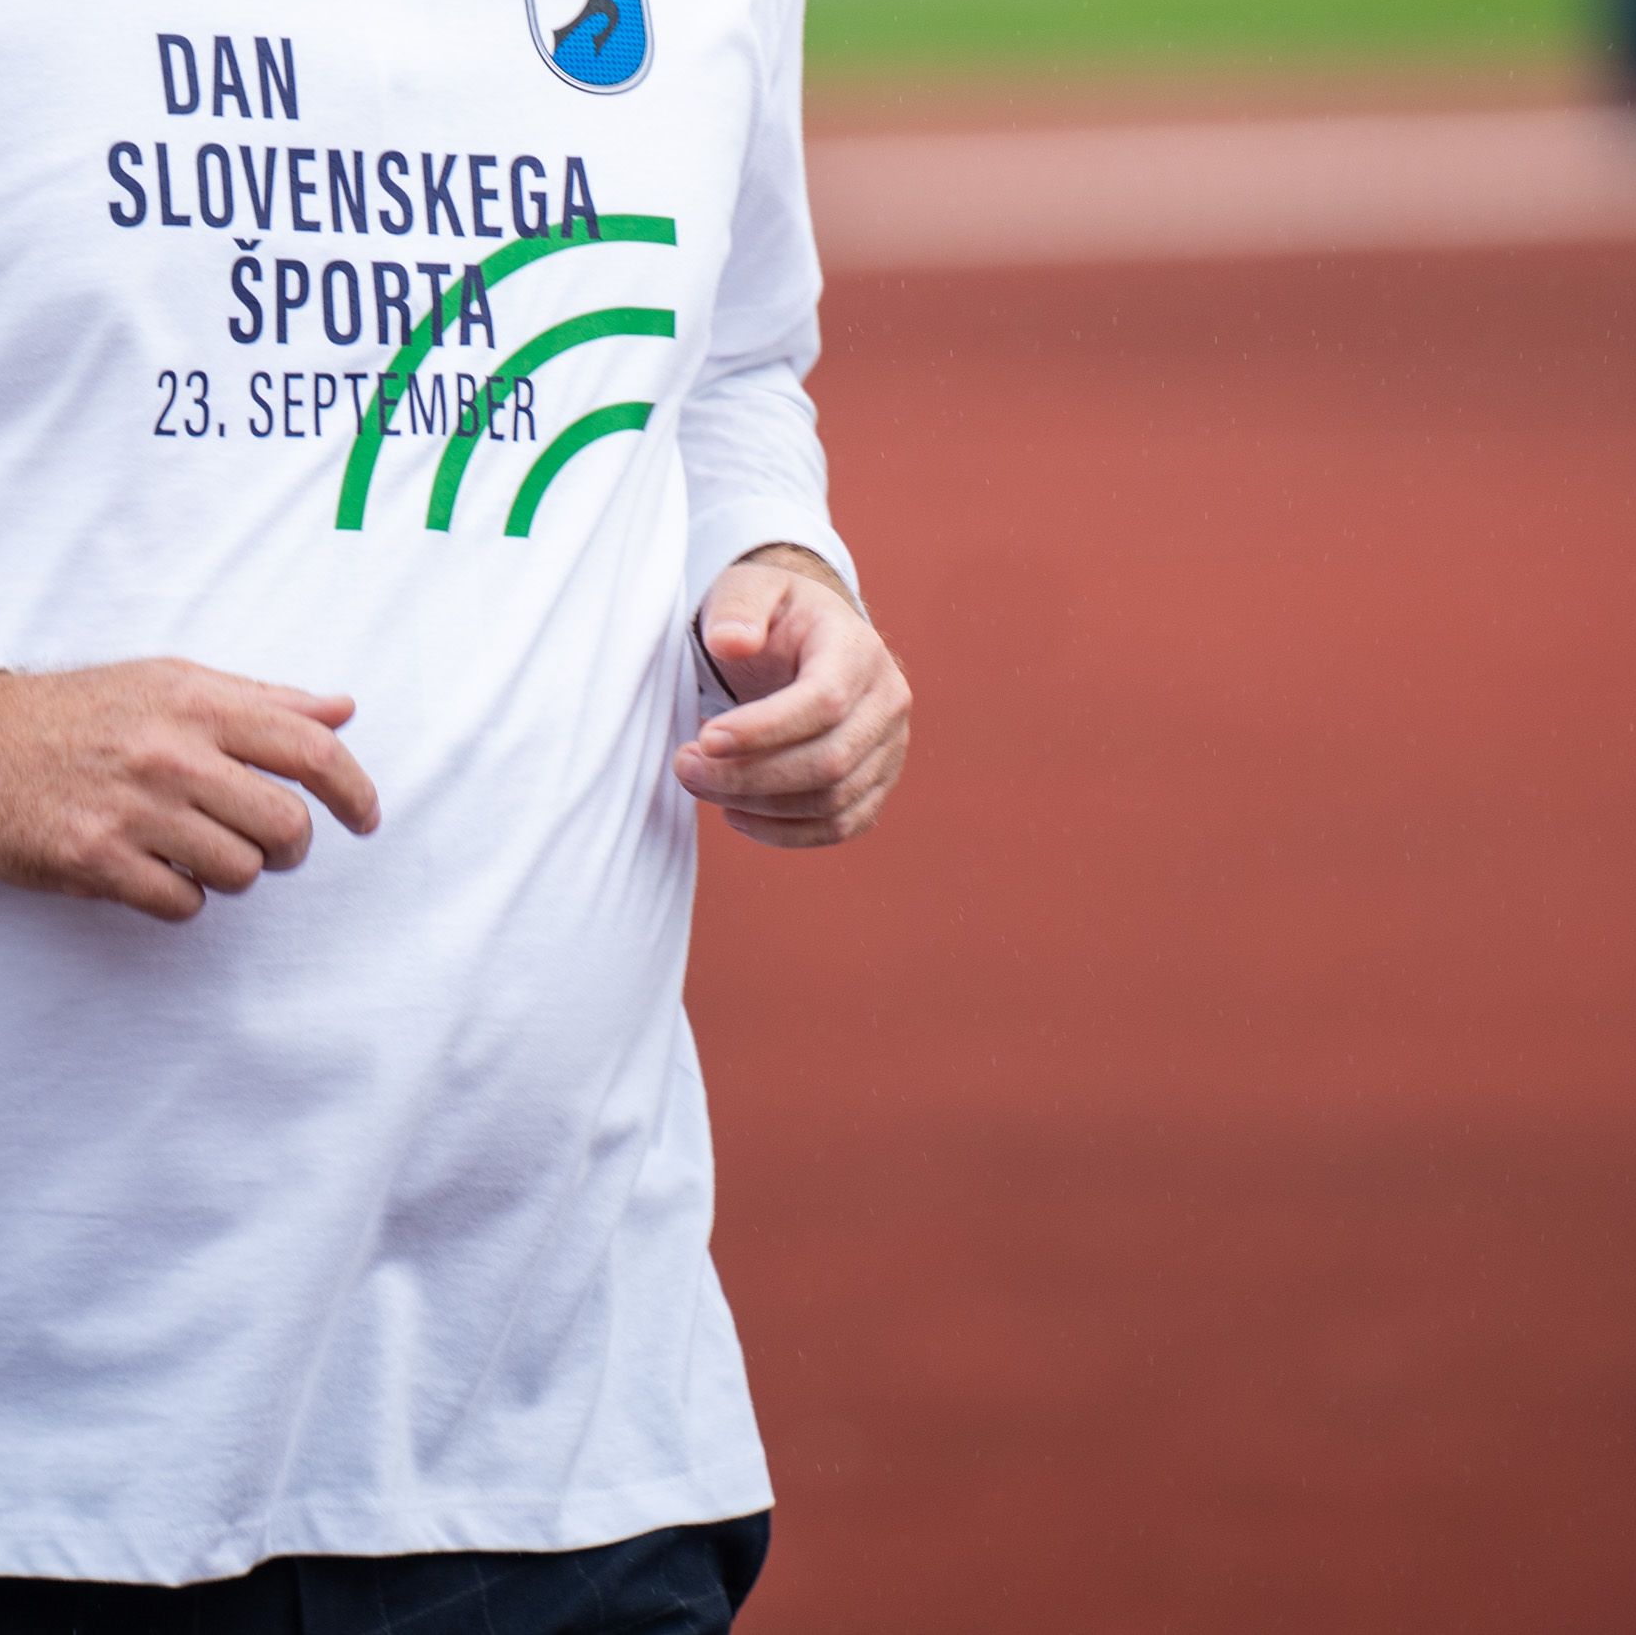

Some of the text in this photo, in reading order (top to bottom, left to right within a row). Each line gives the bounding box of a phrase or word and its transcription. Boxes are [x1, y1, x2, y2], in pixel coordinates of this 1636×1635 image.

[157, 32, 300, 121] DAN
[107, 140, 602, 241] SLOVENSKEGA
[227, 237, 496, 349] ŠPORTA
[153, 369, 537, 441] 23. SEPTEMBER
